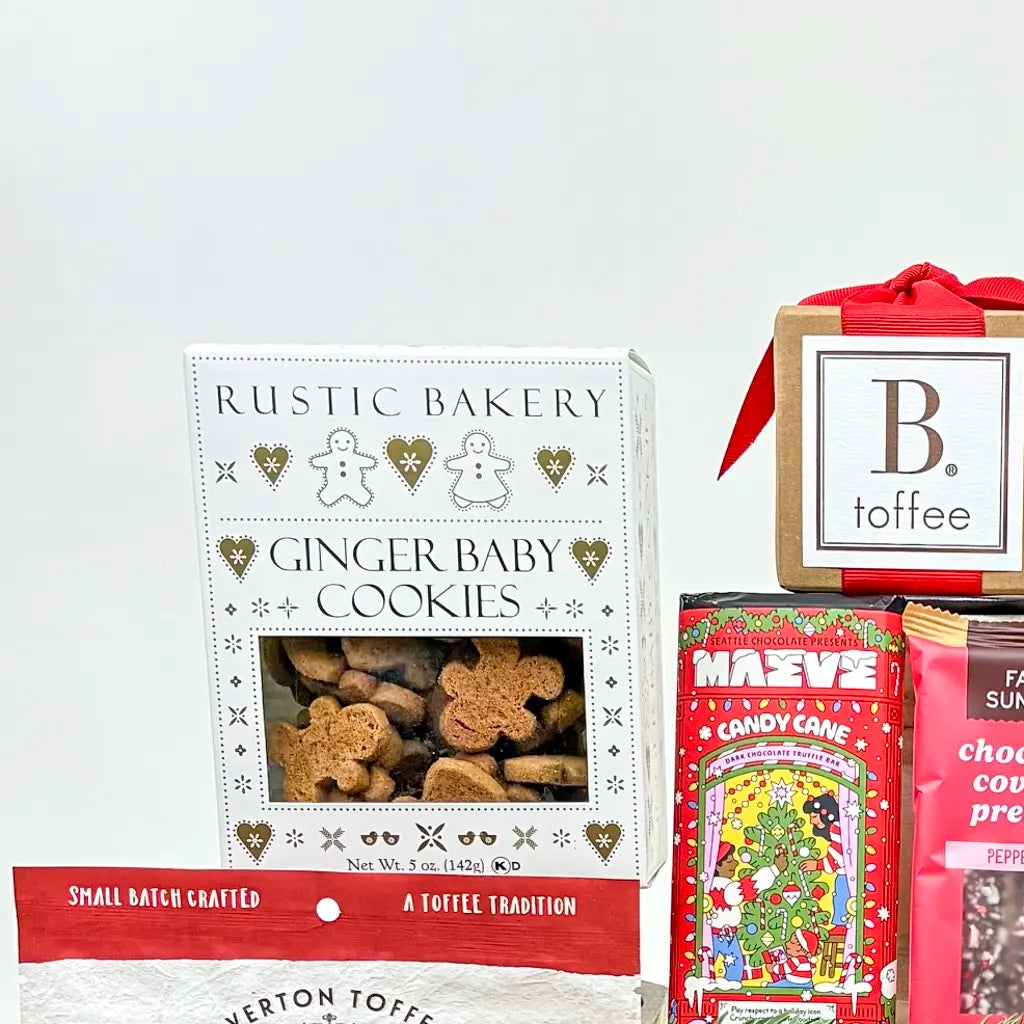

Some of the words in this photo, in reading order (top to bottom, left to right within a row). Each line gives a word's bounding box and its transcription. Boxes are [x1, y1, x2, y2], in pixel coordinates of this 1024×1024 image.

[216, 386, 401, 415] RUSTIC
[425, 388, 606, 417] BAKERY
[855, 491, 970, 530] toffee
[270, 537, 448, 572] GINGER
[456, 538, 561, 572] BABY
[317, 584, 521, 619] COOKIES
[711, 637, 748, 646] SEATTLE
[752, 637, 807, 646] CHOCOLATE
[810, 637, 858, 647] PRESENTS
[717, 714, 790, 741] CANDY
[793, 714, 851, 744] CANE
[725, 753, 745, 765] DARK
[793, 750, 824, 760] TRUFFLE
[826, 757, 840, 767] BAR
[348, 859, 374, 872] Net
[378, 859, 404, 872] Wt.
[409, 859, 416, 871] 5
[419, 861, 440, 872] oz.
[443, 859, 485, 874] (142g)
[68, 885, 124, 908] SMALL
[129, 887, 183, 908] BATCH
[187, 888, 260, 909] CRAFTED
[404, 893, 414, 913] A
[420, 892, 483, 915] TOFFEE
[490, 894, 576, 916] TRADITION
